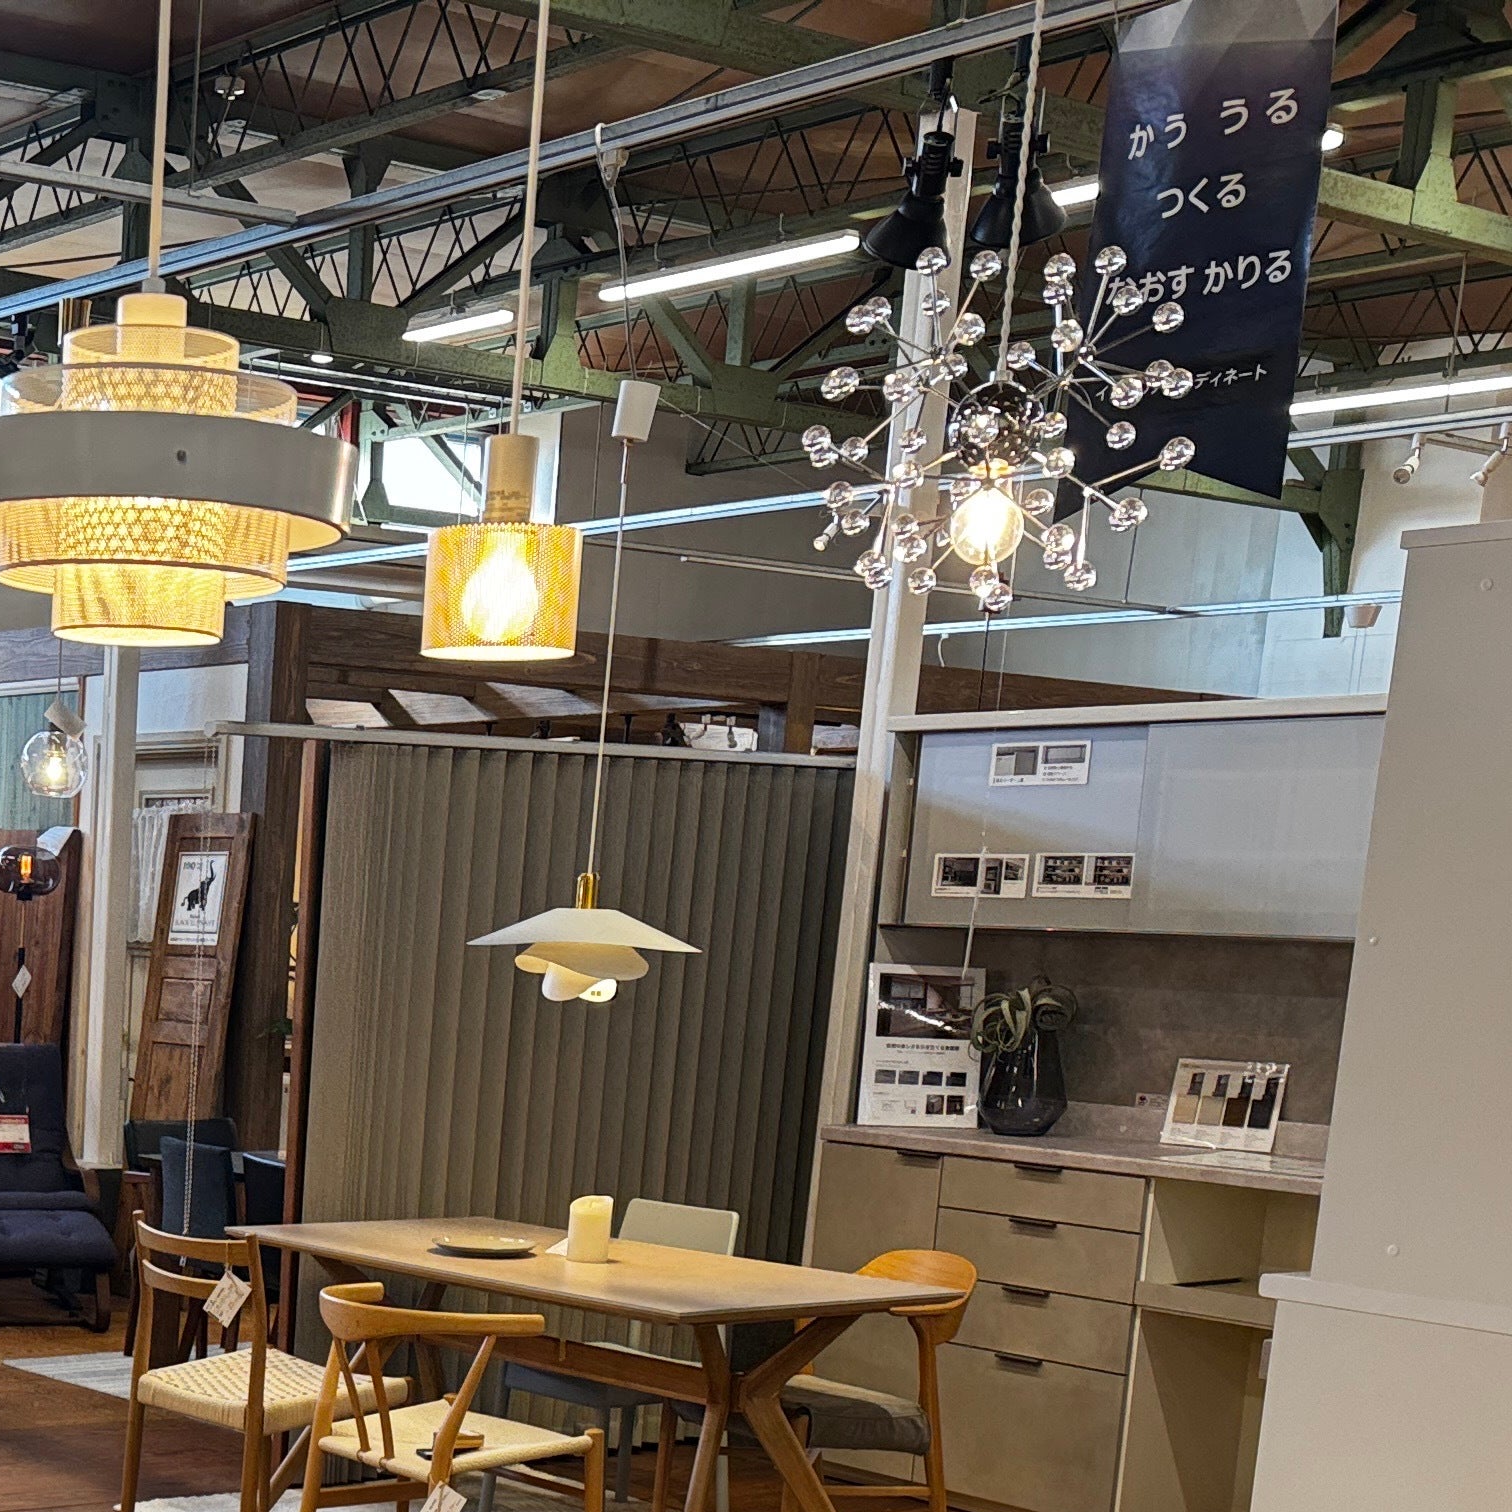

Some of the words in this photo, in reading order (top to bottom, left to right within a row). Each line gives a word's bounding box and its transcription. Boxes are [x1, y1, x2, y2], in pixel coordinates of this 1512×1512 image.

[1127, 114, 1188, 160] かう
[1220, 88, 1299, 136] うる
[1157, 172, 1247, 219] つくる
[1203, 249, 1293, 297] かりる
